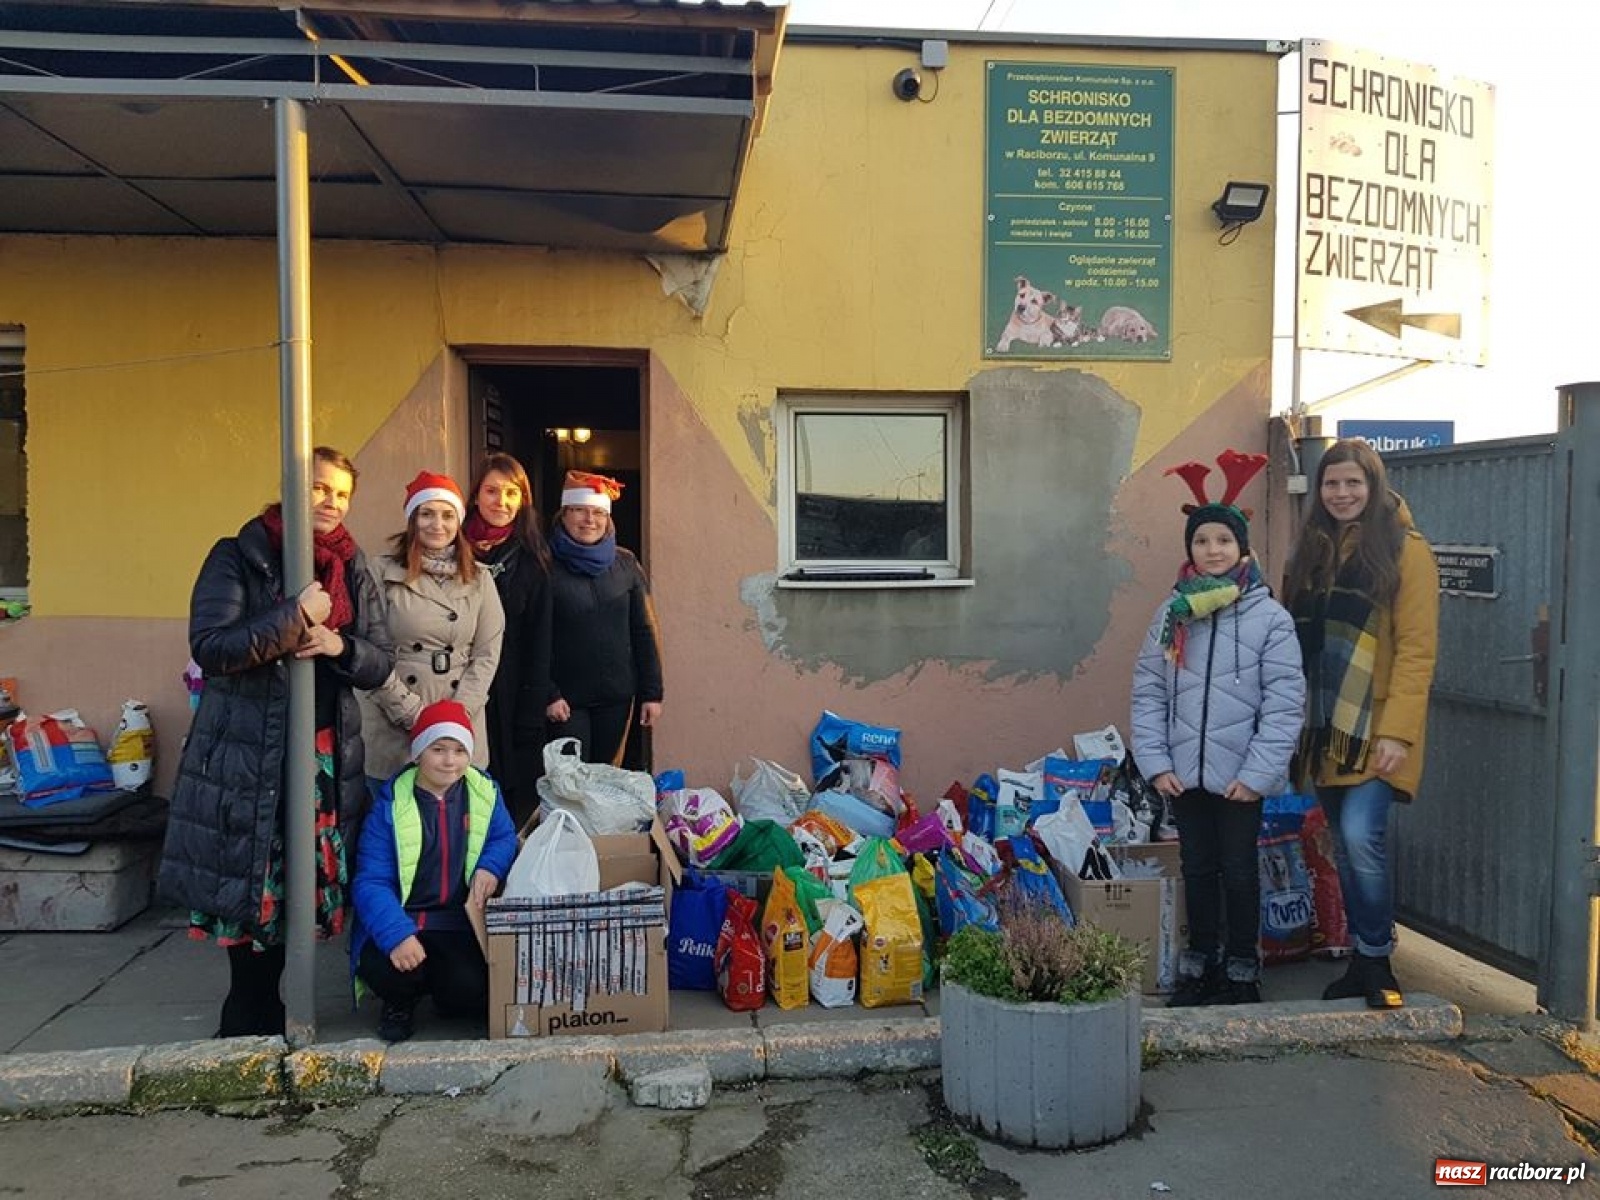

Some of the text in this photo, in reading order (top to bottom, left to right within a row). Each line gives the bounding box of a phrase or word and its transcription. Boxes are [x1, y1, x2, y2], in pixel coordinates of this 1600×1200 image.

[1027, 89, 1131, 108] SCHRONISKO
[1308, 57, 1474, 139] SCHRONISKO
[1007, 109, 1152, 127] DLA BEZDOMNYCH
[1040, 130, 1118, 149] ZWIERZĄT
[1005, 151, 1015, 160] w
[1016, 150, 1071, 161] Raciborzu,
[1074, 151, 1087, 161] ul.
[1089, 151, 1146, 162] Komunalna
[1384, 131, 1436, 184] DLA
[1038, 168, 1053, 178] tel.
[1059, 168, 1073, 178] 32
[1074, 168, 1092, 179] 415
[1109, 169, 1121, 179] 44
[1035, 180, 1060, 190] kom.
[1306, 172, 1481, 245] BEZDOMNYCH
[1094, 217, 1116, 227] 8.00
[1094, 229, 1116, 238] 8.00
[1069, 255, 1155, 267] Oglądanie zwierząt
[1304, 229, 1438, 297] ZWIERZĄT
[1087, 267, 1137, 276] codziennie
[1074, 277, 1099, 287] godz.
